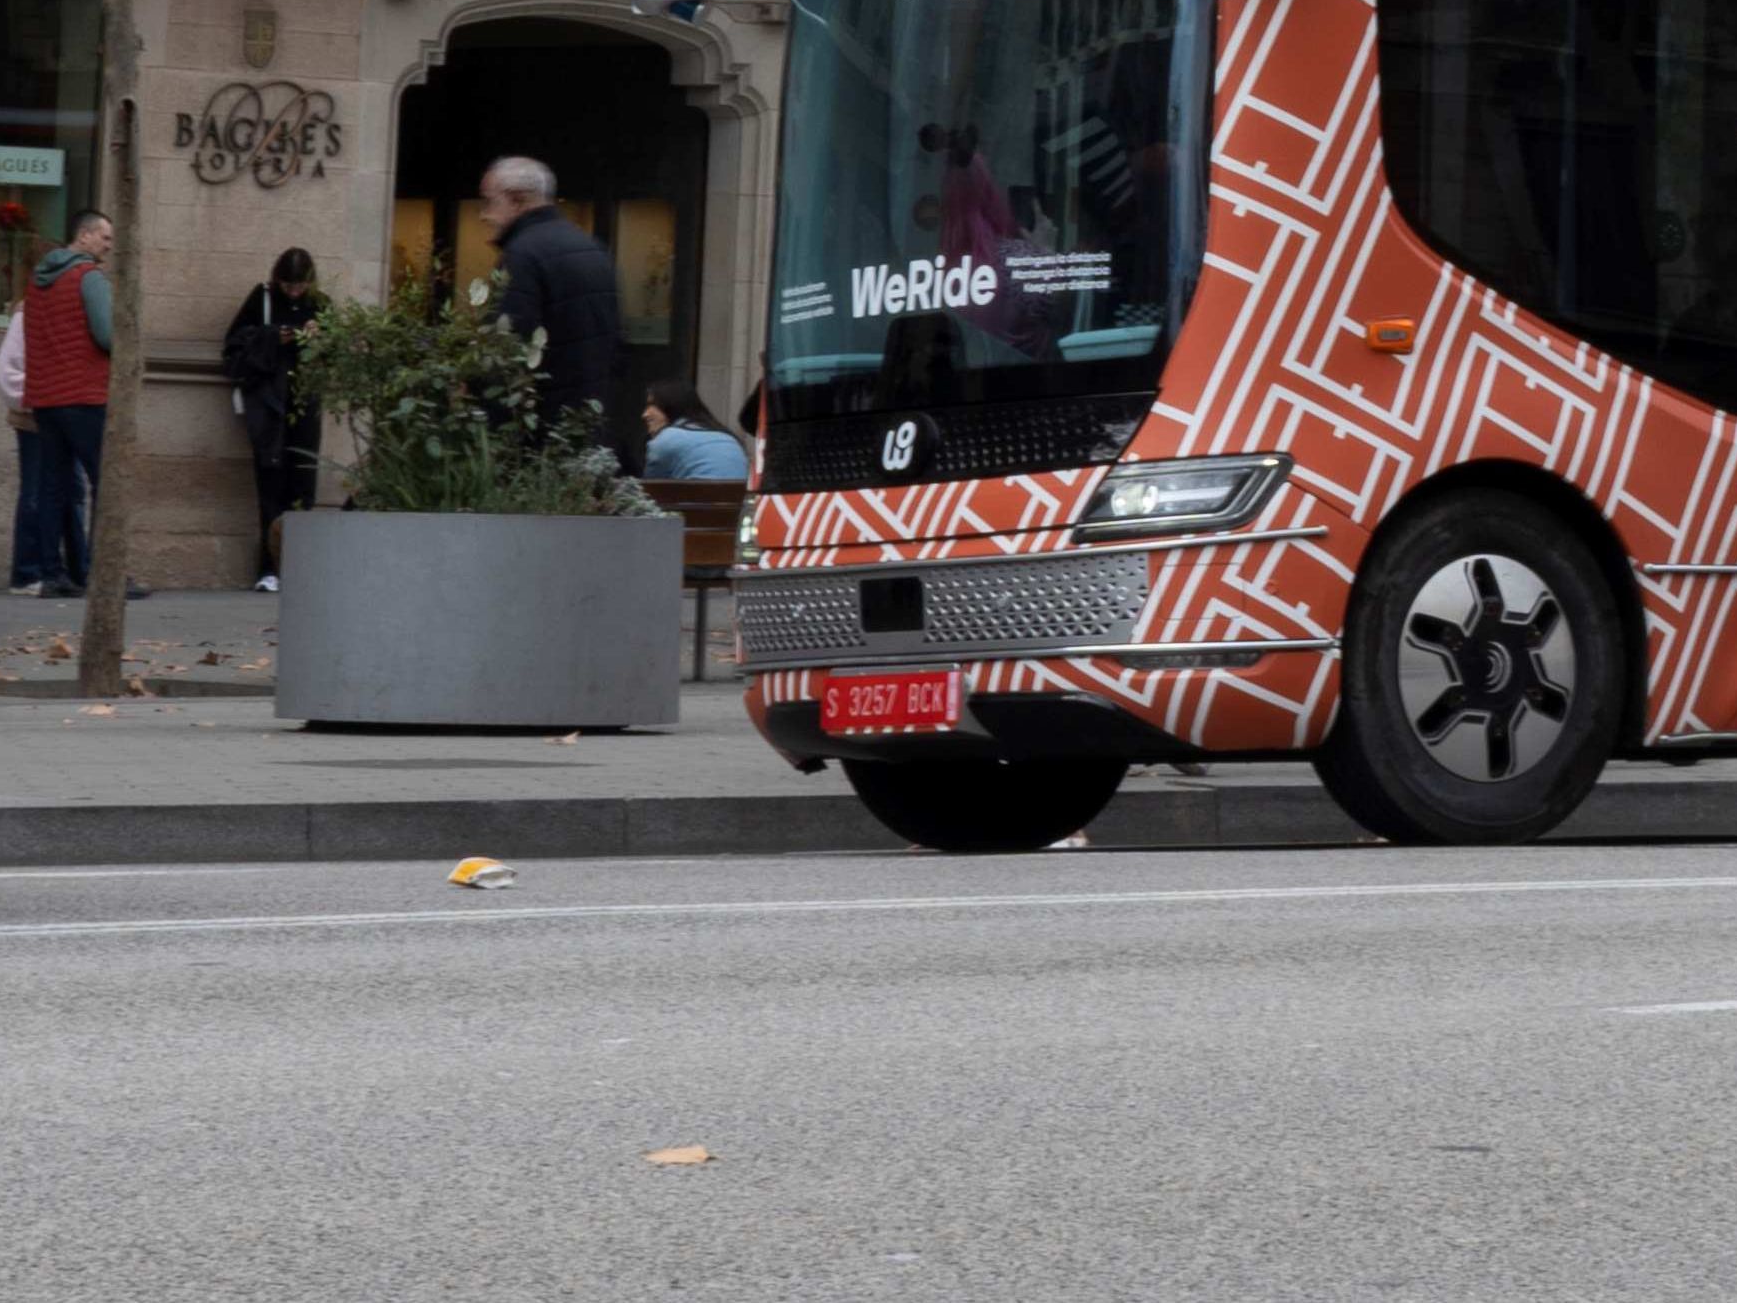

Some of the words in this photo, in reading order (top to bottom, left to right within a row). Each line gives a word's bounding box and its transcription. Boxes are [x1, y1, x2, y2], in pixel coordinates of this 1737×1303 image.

[852, 255, 998, 318] WeRide
[826, 687, 839, 718] S
[849, 683, 898, 718] 3257
[907, 681, 945, 714] BCK
